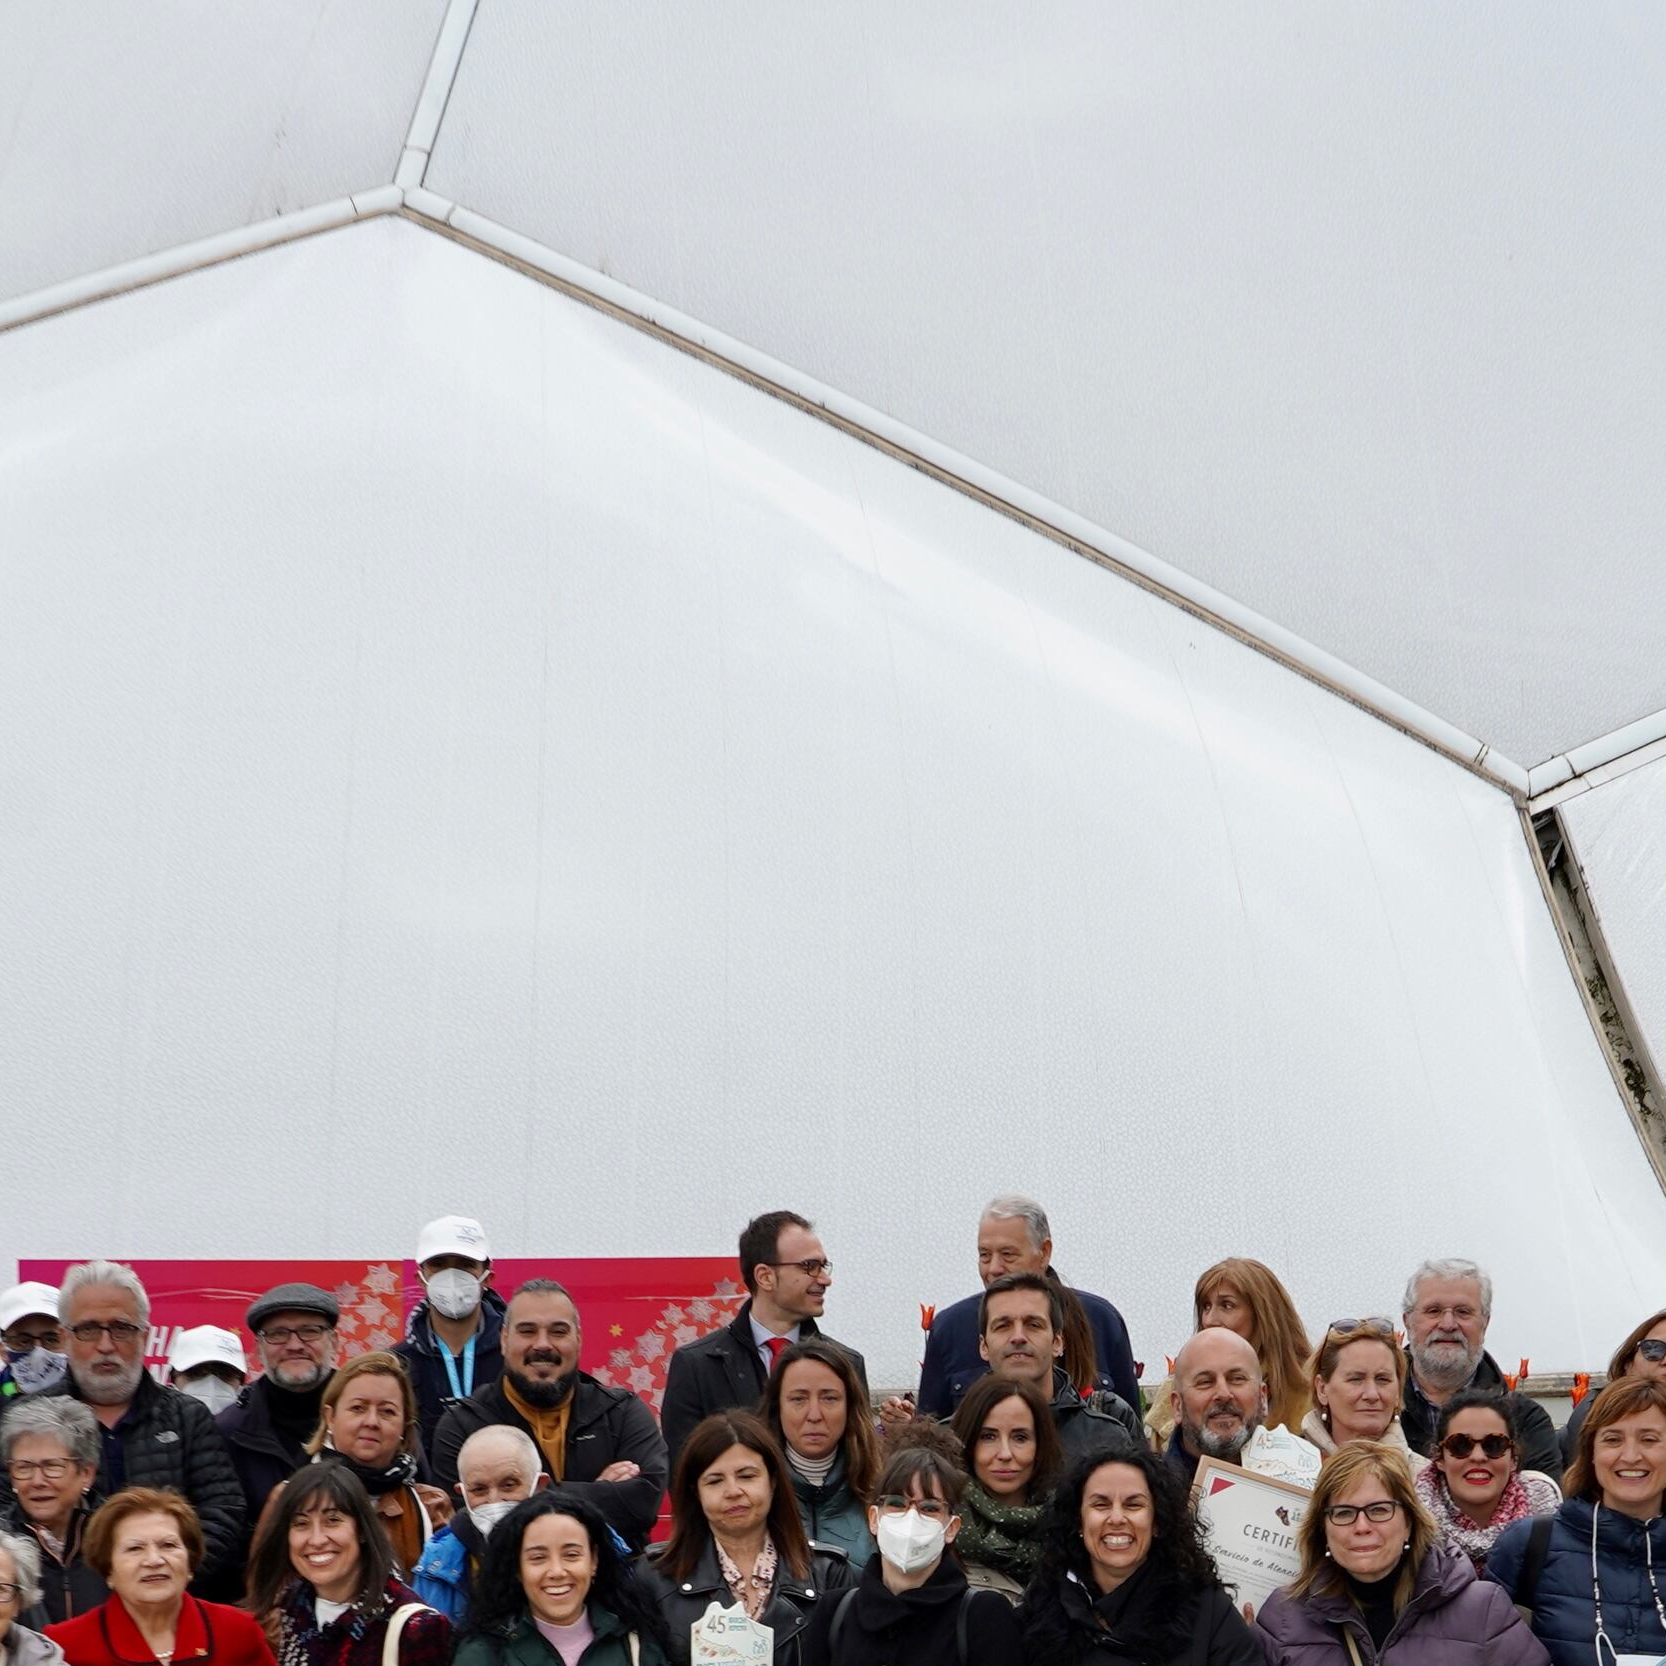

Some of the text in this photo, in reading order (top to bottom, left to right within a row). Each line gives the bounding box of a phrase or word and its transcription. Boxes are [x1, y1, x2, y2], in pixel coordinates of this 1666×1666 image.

[1243, 1523, 1299, 1552] CERTIFI
[1266, 1562, 1299, 1578] Atenci
[706, 1614, 726, 1634] 45
